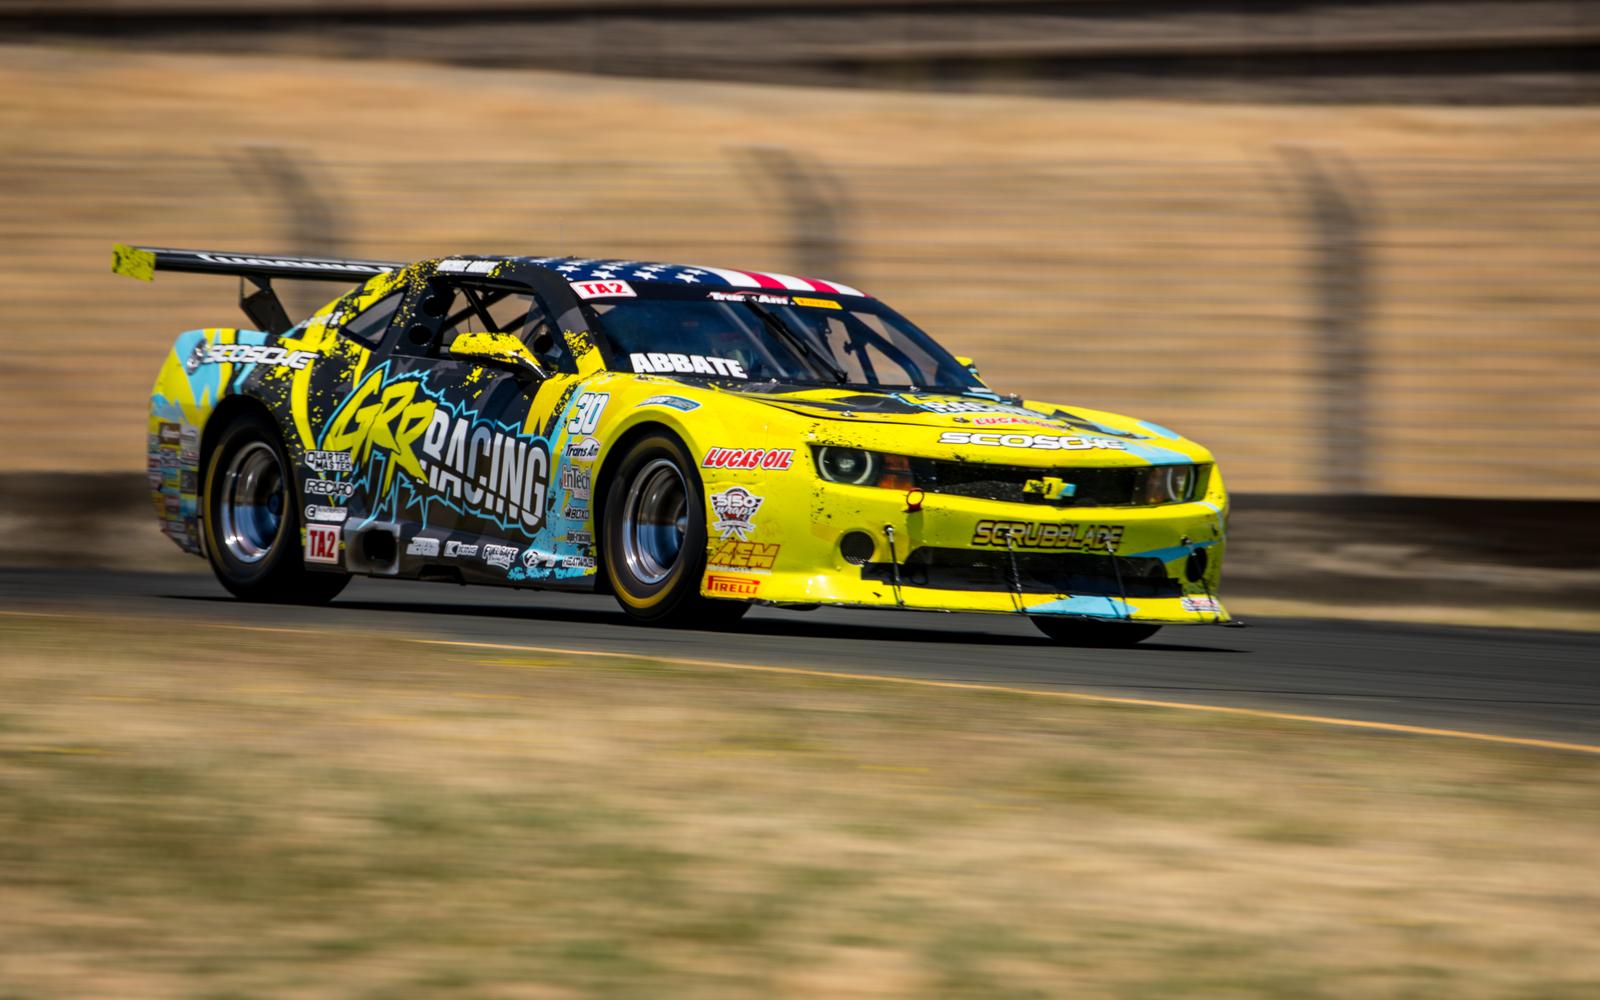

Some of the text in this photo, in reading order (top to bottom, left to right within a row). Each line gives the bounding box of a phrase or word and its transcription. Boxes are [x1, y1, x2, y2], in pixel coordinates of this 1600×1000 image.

[582, 281, 627, 298] TA2
[708, 292, 758, 302] Tran
[204, 344, 318, 369] SCOSCHE
[631, 353, 748, 379] ABBATE
[567, 393, 609, 434] 30
[940, 432, 1127, 450] SCOSCHE
[305, 451, 352, 464] QUARTER
[565, 444, 599, 458] Trans Am
[703, 449, 793, 470] LUCAS OIL
[315, 461, 353, 472] MASTER
[416, 409, 549, 526] RACING
[306, 481, 354, 497] RECARO
[309, 530, 336, 558] TA2
[972, 520, 1125, 552] SCRUBBLADE
[707, 575, 760, 594] PIRELLI
